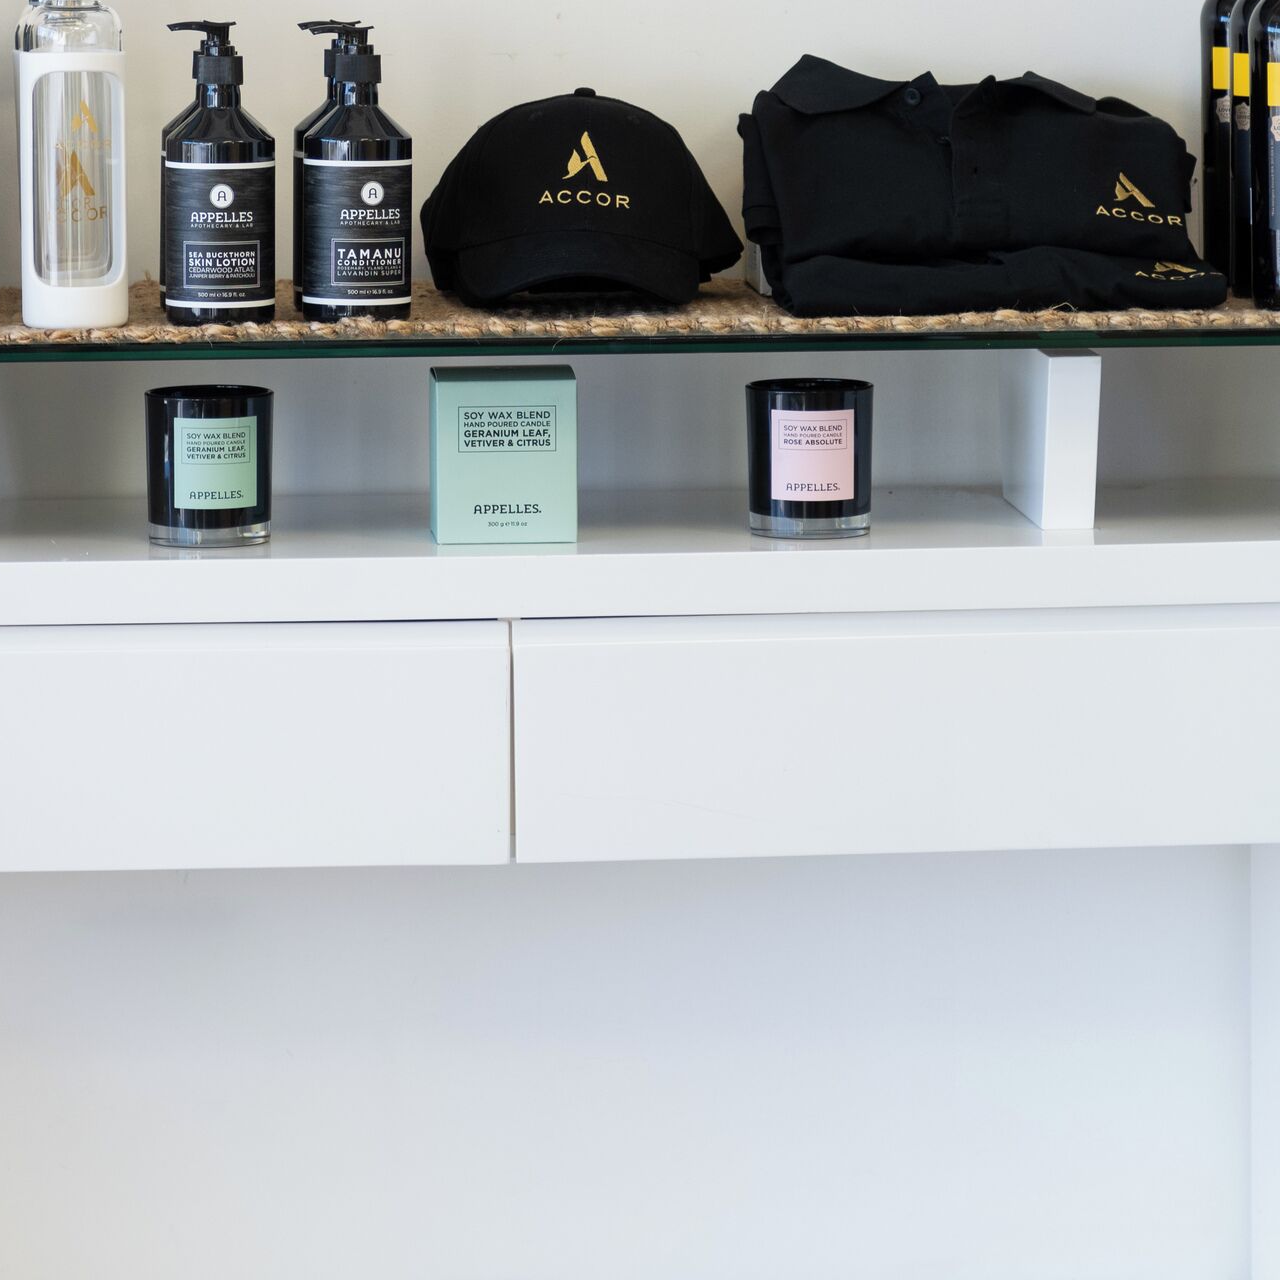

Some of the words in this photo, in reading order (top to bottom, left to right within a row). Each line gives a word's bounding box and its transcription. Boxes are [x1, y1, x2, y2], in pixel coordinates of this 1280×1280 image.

[538, 189, 632, 210] ACCOR
[191, 211, 253, 223] APPELLES
[340, 208, 400, 220] APPELLES
[1095, 205, 1183, 226] ACCOR
[337, 248, 401, 259] TAMANU
[189, 259, 213, 267] SKIN
[216, 258, 255, 267] LOTION
[464, 411, 485, 420] SOY
[487, 411, 513, 420] WAX
[516, 410, 551, 420] BLEND
[464, 429, 519, 438] GERANIUM
[522, 429, 551, 438] LEAF,
[464, 439, 505, 448] VETIVER
[507, 439, 514, 447] &
[516, 438, 551, 447] CITRUS
[805, 438, 843, 446] ABSOLUTE
